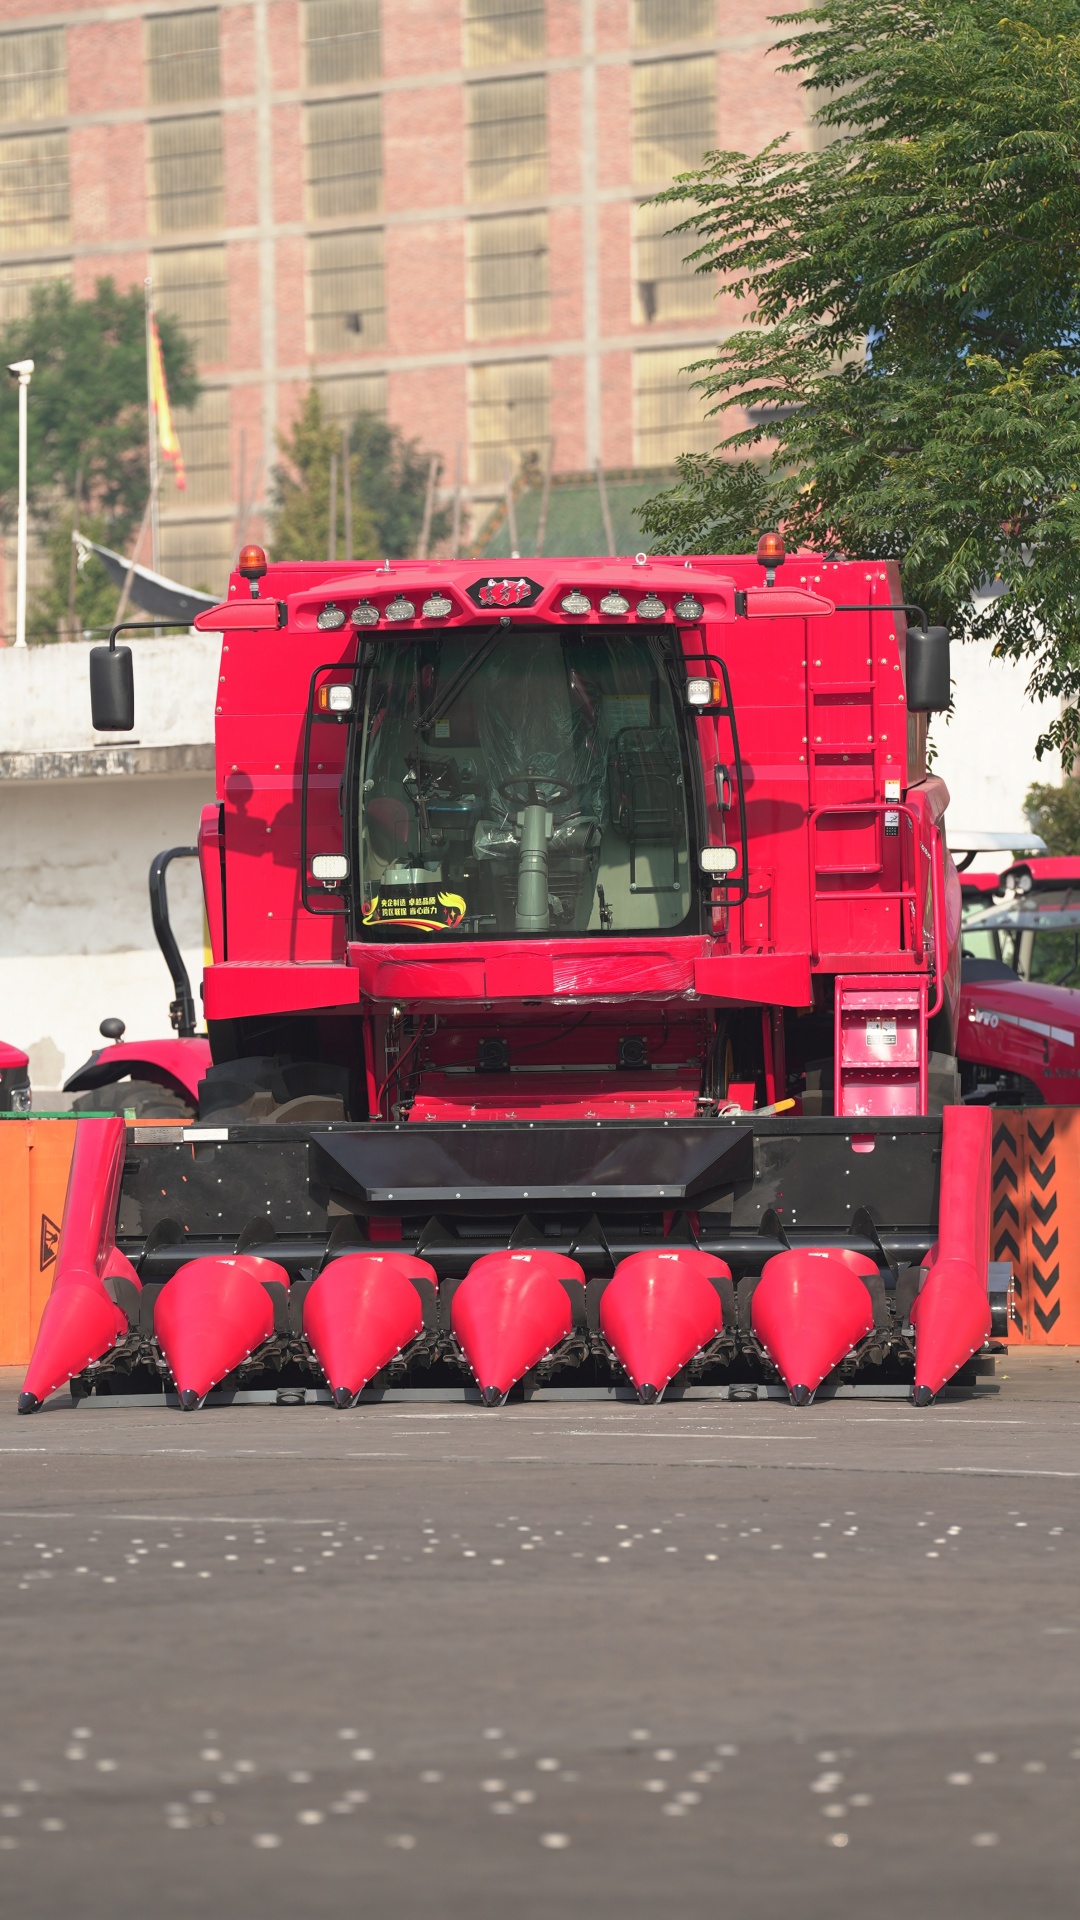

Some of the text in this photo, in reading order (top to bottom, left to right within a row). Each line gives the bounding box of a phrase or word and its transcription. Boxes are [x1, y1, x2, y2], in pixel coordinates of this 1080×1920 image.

[381, 896, 436, 907] 央企制造 卓越品质
[409, 906, 438, 915] 省心省力
